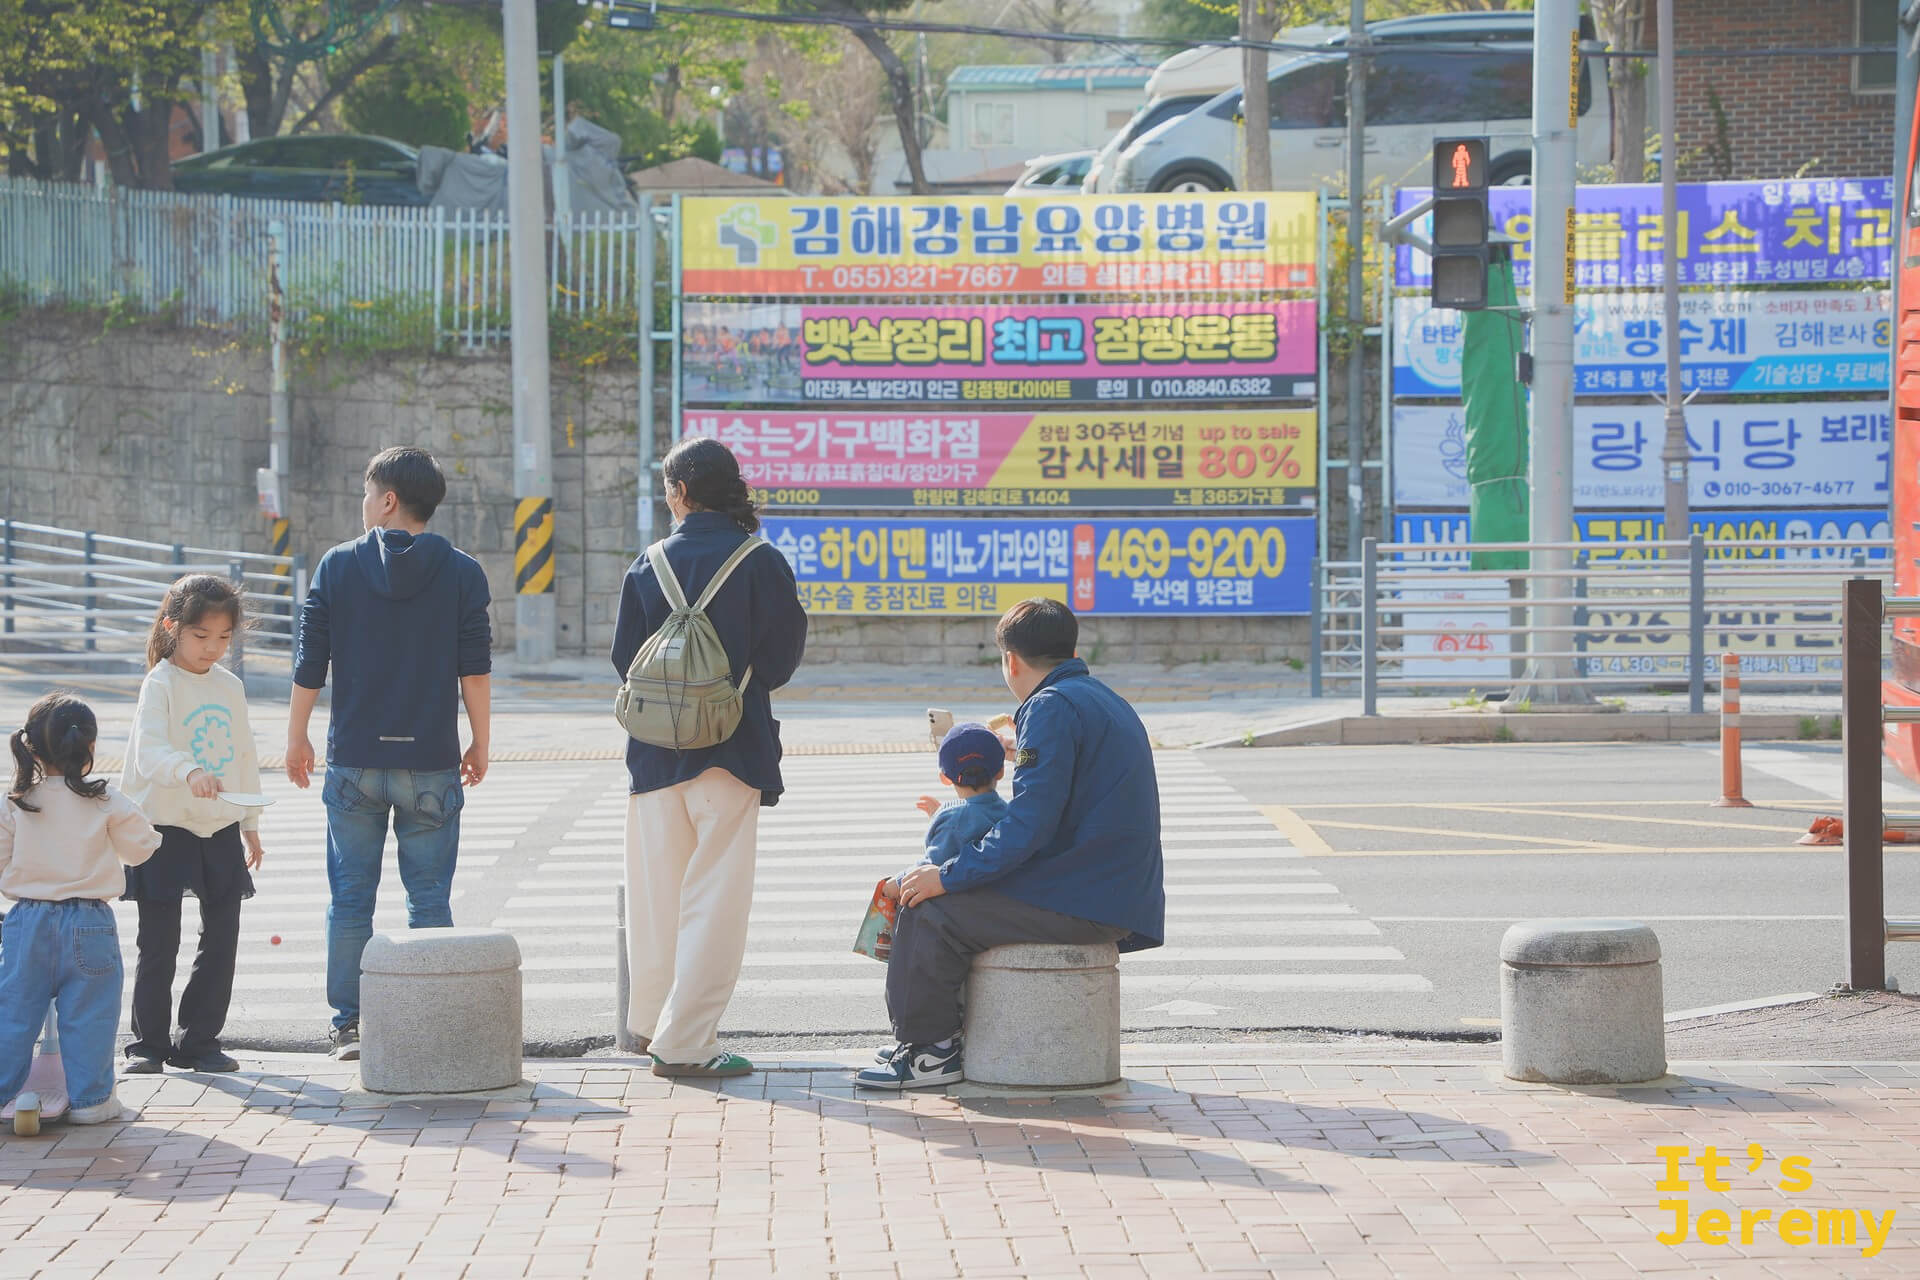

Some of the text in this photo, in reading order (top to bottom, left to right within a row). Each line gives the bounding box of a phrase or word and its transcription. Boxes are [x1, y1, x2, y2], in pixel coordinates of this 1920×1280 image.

[790, 201, 1267, 256] 김해강남요양병원
[832, 265, 1019, 288] 055)321-7667
[803, 314, 1278, 368] 뱃살정리 최고 점핑운동
[1775, 321, 1825, 349] 김해
[927, 379, 959, 399] 인근
[1075, 421, 1147, 442] 30주년
[1152, 424, 1184, 441] 기념
[1038, 443, 1301, 480] 감사세일 80%
[1027, 489, 1070, 505] 1404
[1724, 481, 1854, 496] 010-3067-4677
[931, 528, 1069, 578] 비뇨기과의원
[1097, 527, 1286, 578] 469-9200
[863, 584, 948, 610] 중점진료
[957, 584, 997, 611] 의원
[1131, 579, 1189, 606] 부산역
[1196, 579, 1254, 606] 맞은편
[1574, 606, 1672, 643] 026
